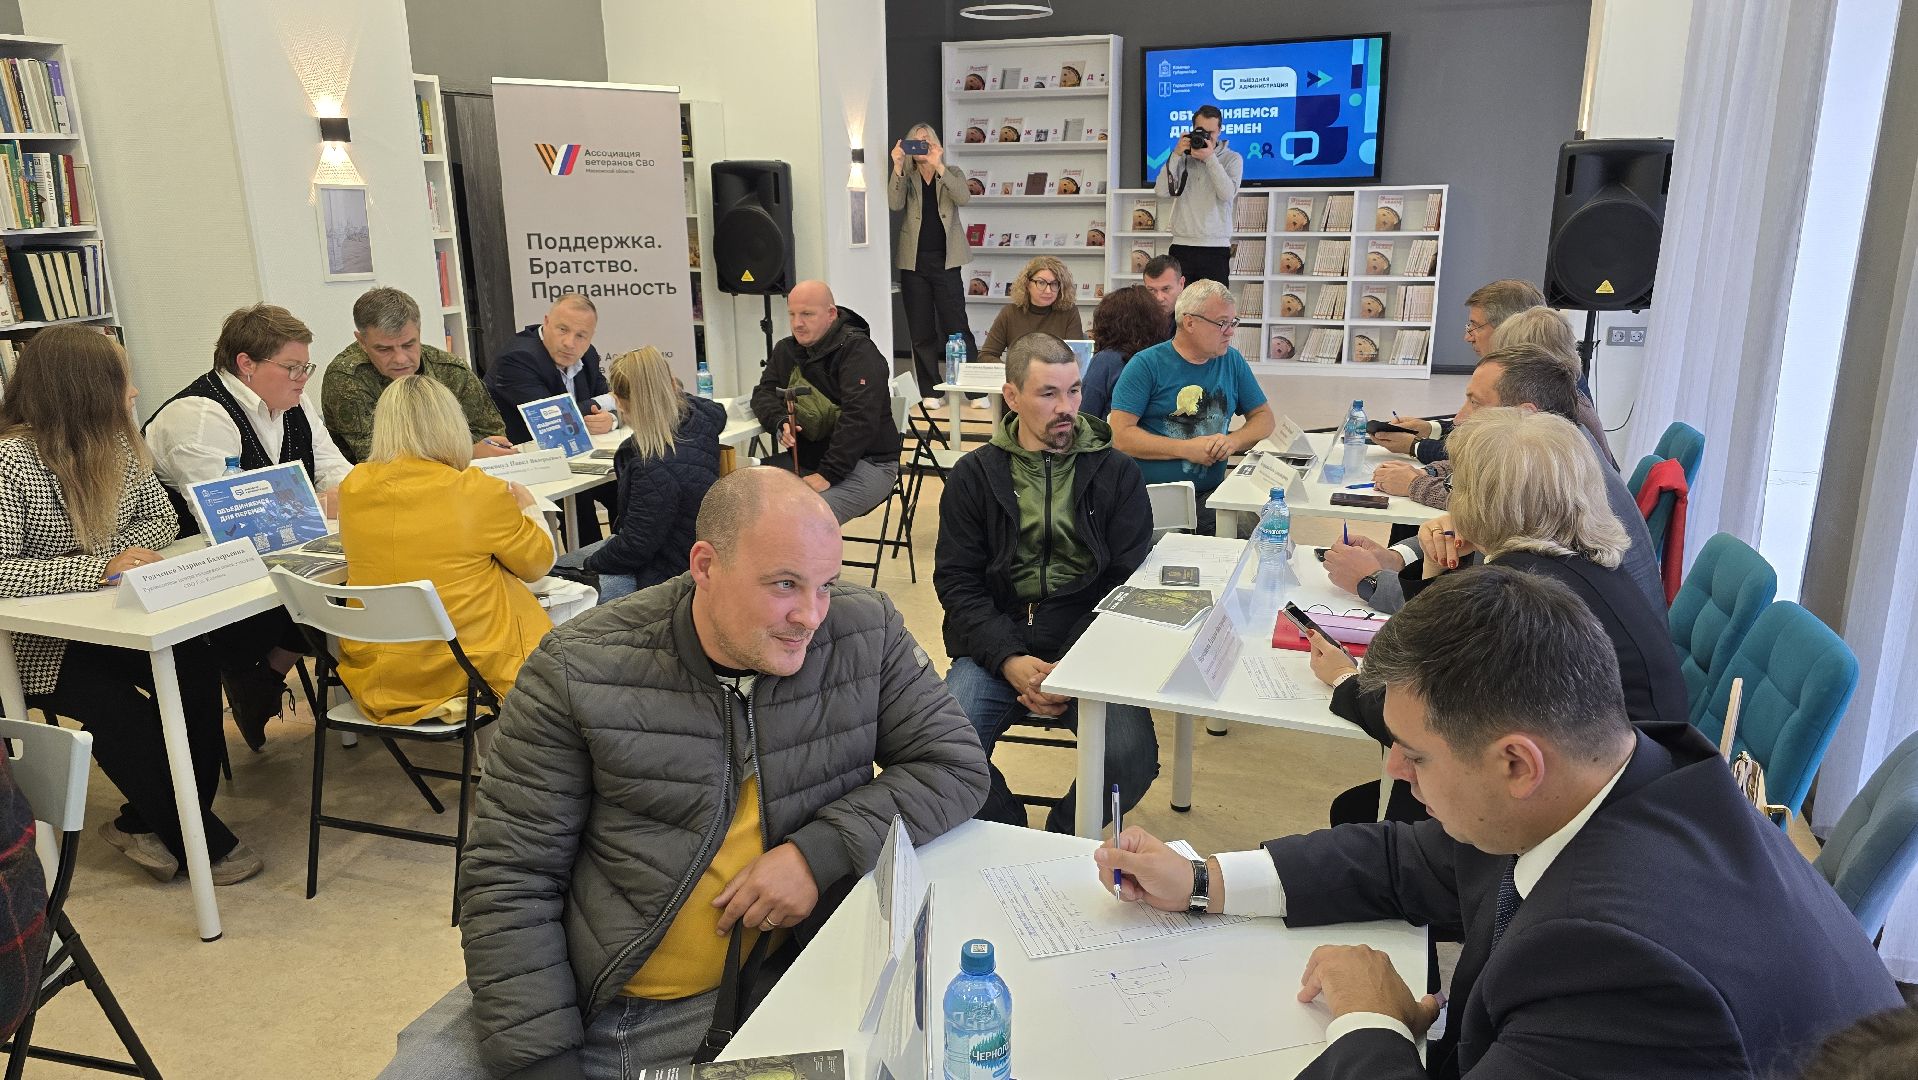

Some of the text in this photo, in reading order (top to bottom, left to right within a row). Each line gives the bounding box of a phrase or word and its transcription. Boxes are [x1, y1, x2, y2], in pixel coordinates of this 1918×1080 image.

[584, 149, 641, 158] Ассоциация
[585, 159, 655, 167] ветеранов СВО
[526, 233, 662, 253] Поддержка.
[529, 257, 638, 279] Братство.
[531, 281, 677, 302] Преданность
[177, 560, 206, 572] Марина
